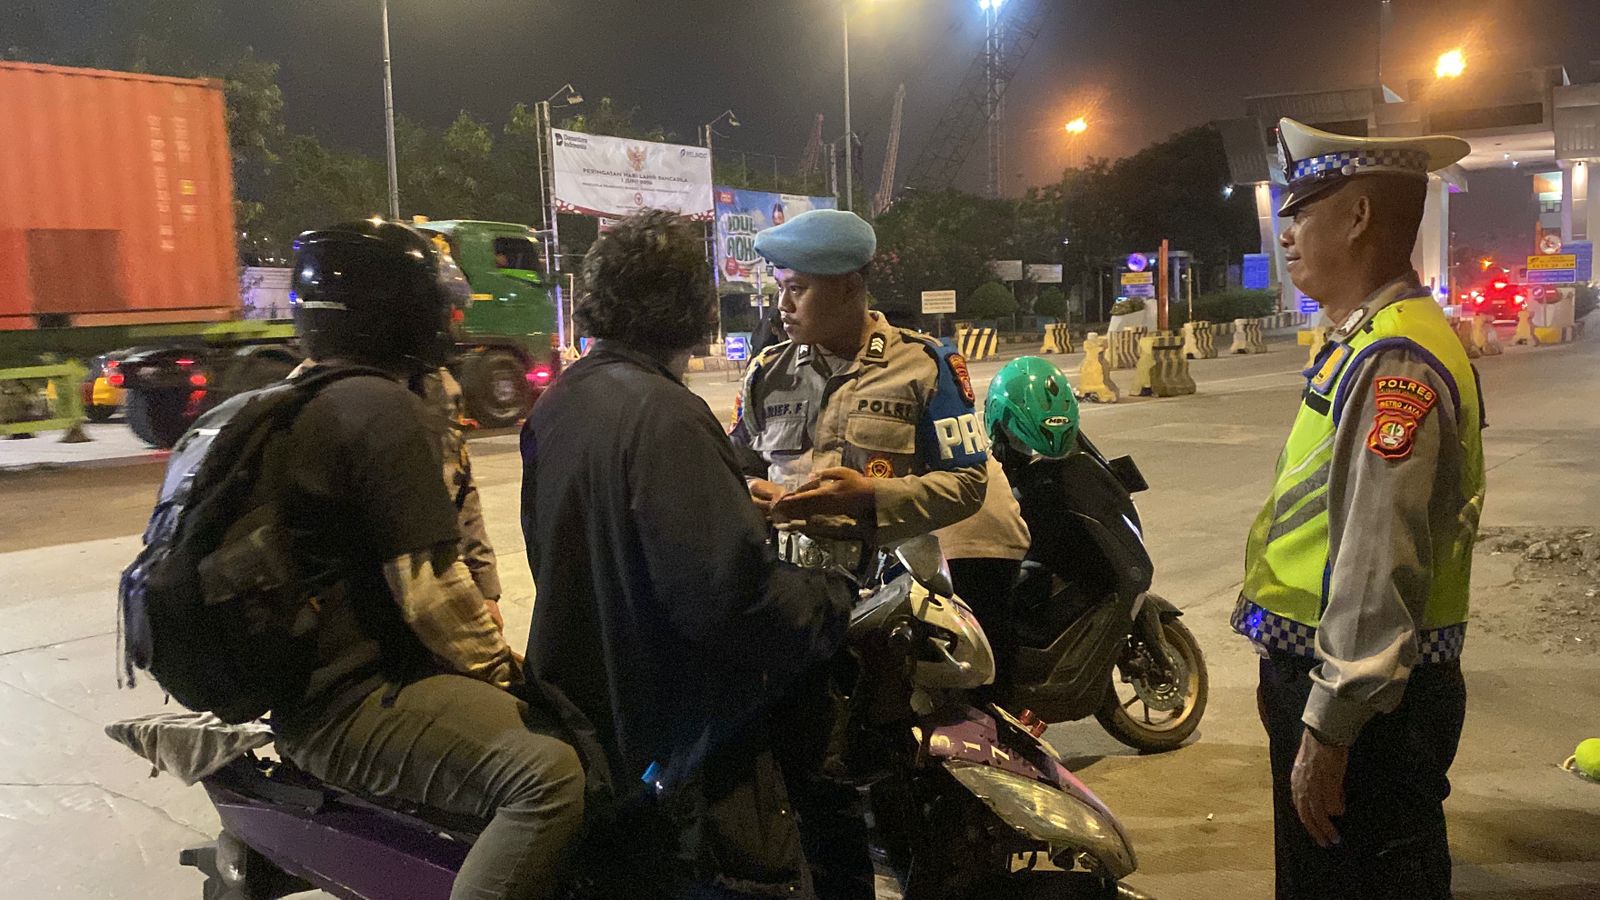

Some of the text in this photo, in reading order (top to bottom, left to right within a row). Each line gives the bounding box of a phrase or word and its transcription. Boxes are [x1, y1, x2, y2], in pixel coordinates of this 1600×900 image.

[582, 167, 622, 177] PERINGATAN
[727, 215, 757, 234] IDUL
[1378, 379, 1433, 401] POLRES
[858, 399, 912, 417] POLRI
[1403, 404, 1421, 416] JAYA
